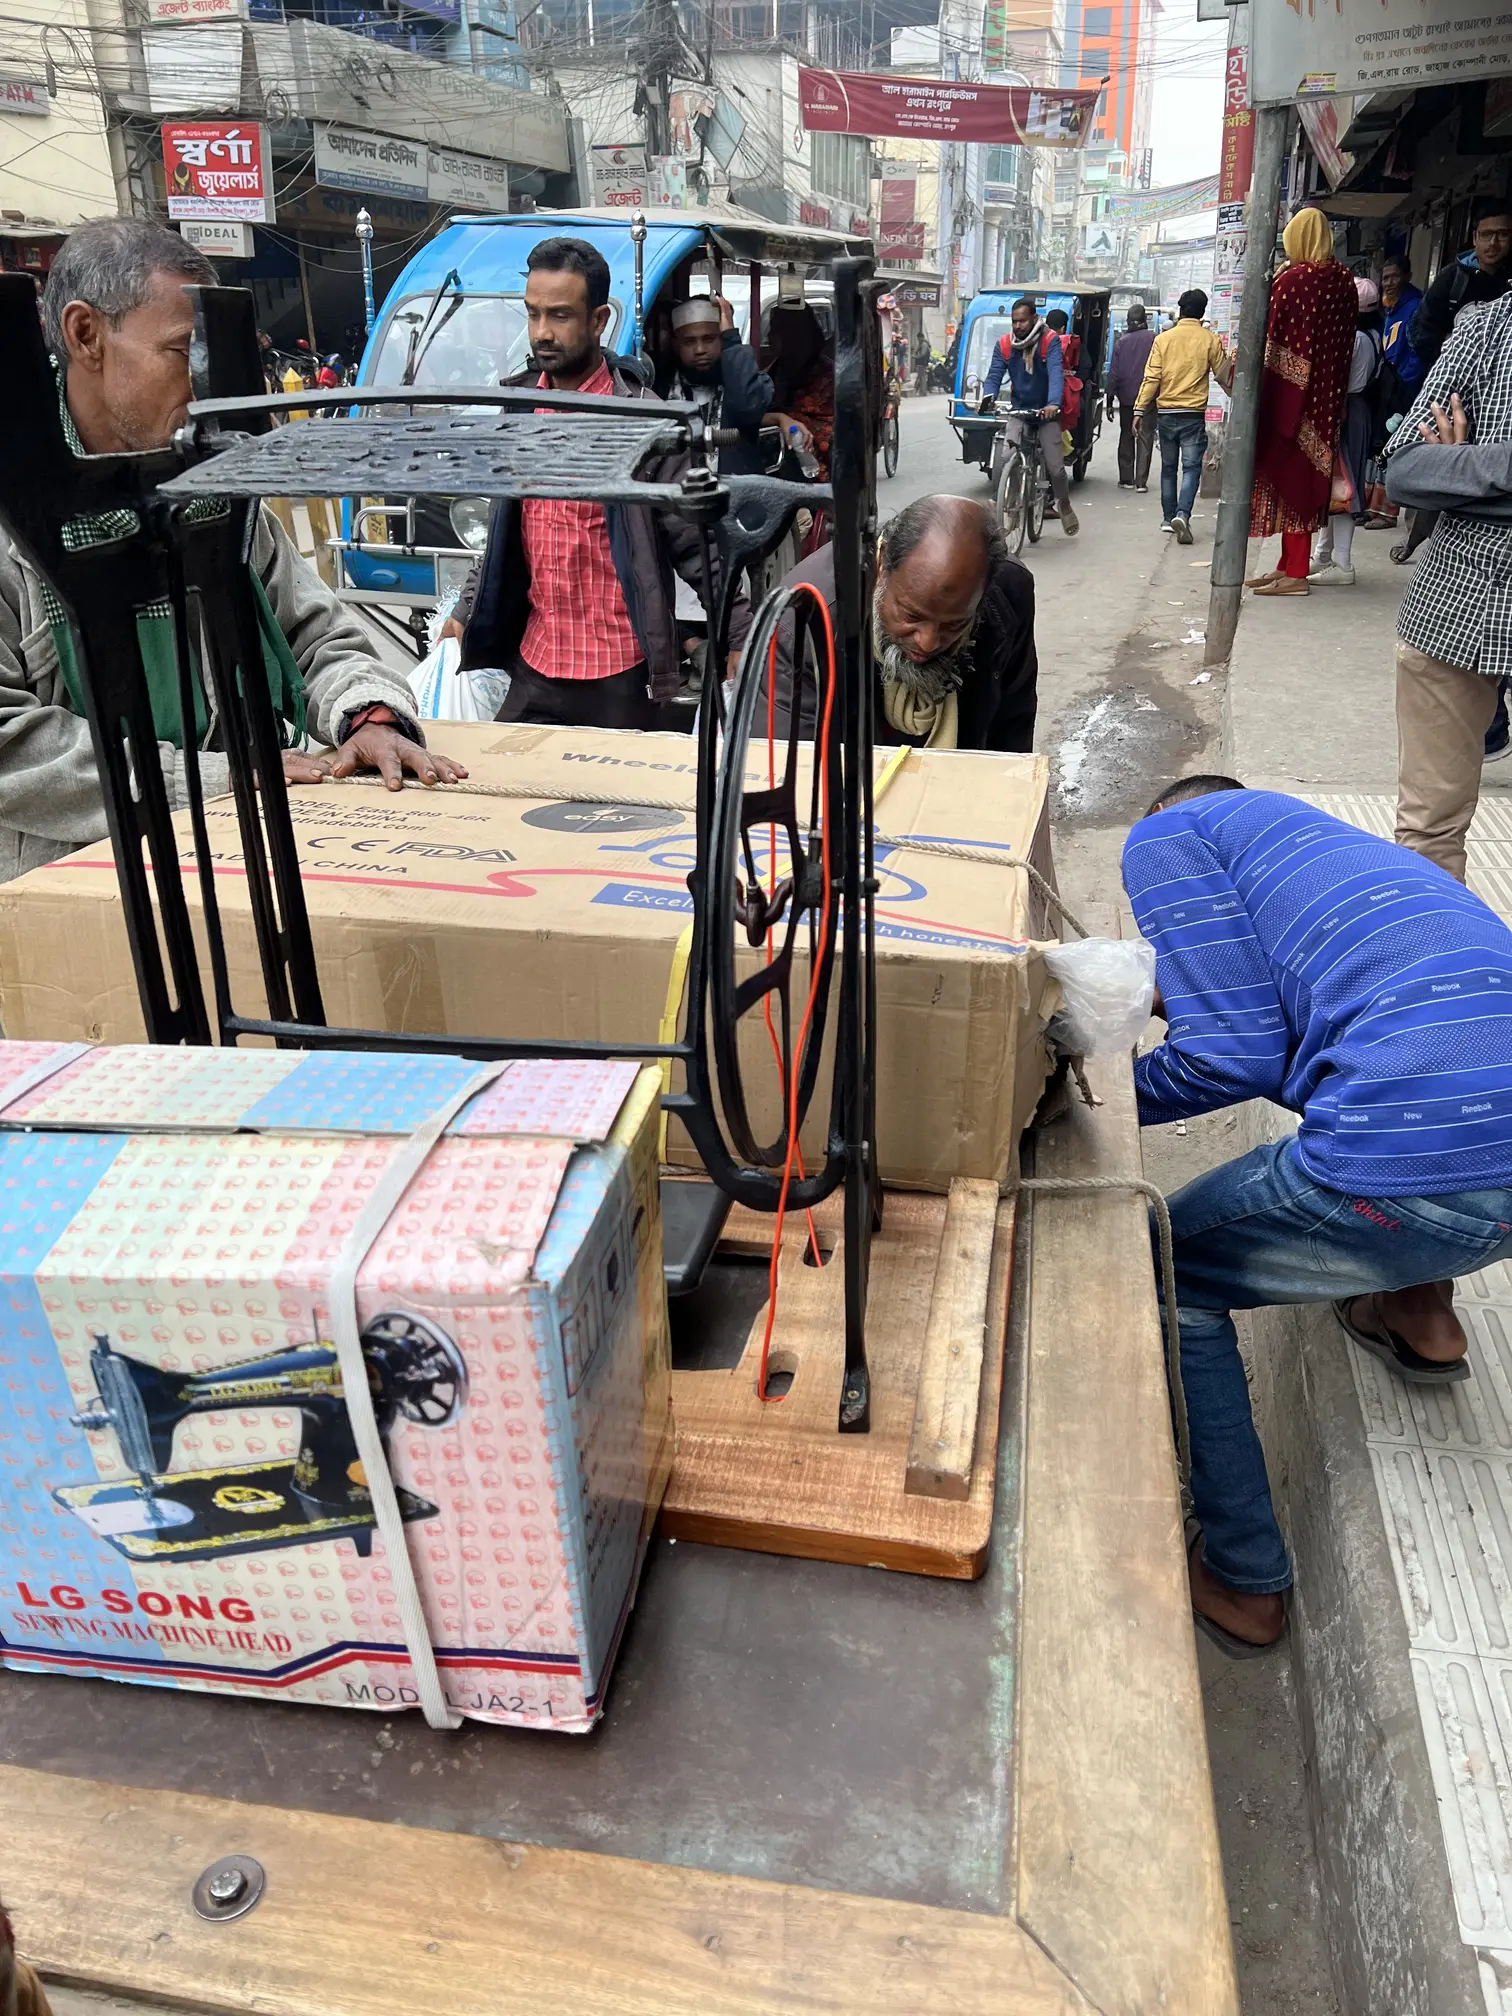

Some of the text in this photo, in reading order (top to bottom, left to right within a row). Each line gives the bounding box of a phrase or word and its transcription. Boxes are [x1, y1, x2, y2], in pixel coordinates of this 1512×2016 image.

[172, 129, 253, 166] স্বর্ণা
[197, 165, 259, 196] জুয়েলার্স
[604, 188, 642, 207] এজেন্ট
[200, 226, 239, 239] IDEAL
[318, 810, 341, 819] IN
[344, 812, 408, 823] CHINA
[354, 805, 403, 817] Easy
[387, 841, 518, 862] FDA
[313, 859, 408, 874] CHINA
[1251, 863, 1268, 877] New
[1322, 916, 1340, 931] New
[1340, 1101, 1493, 1123] Reebok New Reebok
[16, 1581, 256, 1624] LG SONG
[12, 1611, 293, 1654] SEWING MACHINE HEAD
[346, 1682, 554, 1717] MODL JA2-1
